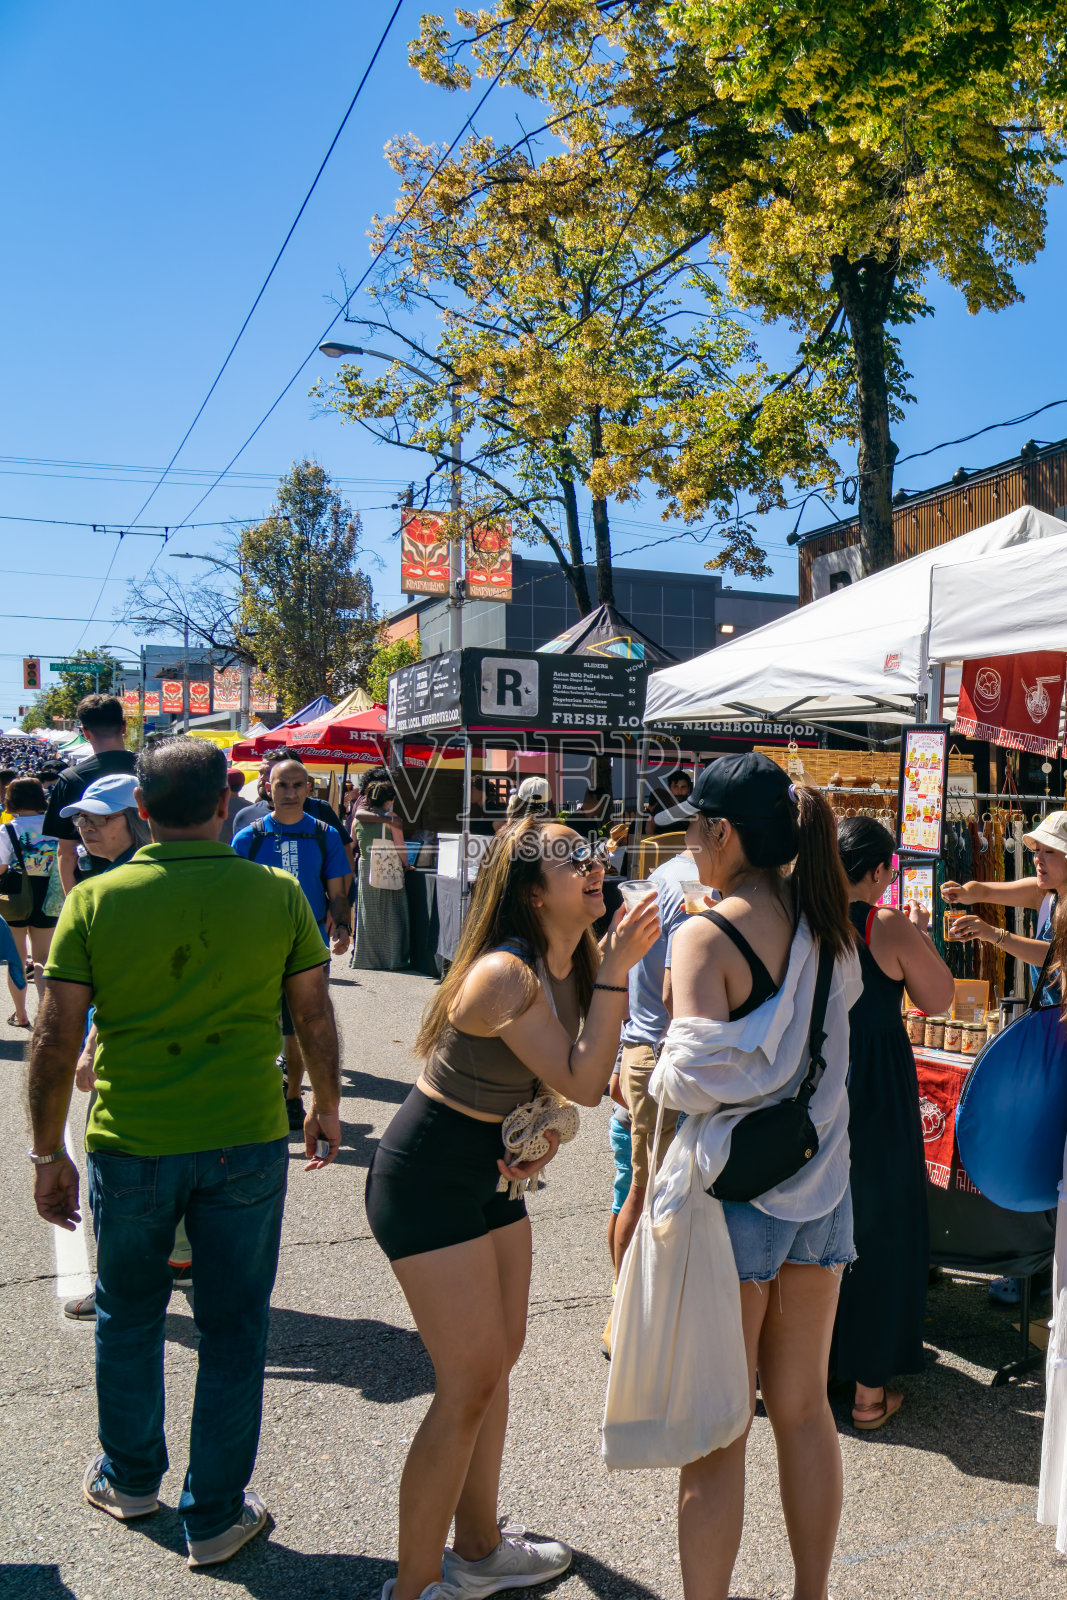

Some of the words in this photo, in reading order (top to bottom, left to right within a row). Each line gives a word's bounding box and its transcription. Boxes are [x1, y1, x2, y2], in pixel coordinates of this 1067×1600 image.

[625, 659, 648, 673] WOW!
[497, 668, 522, 706] R
[551, 712, 612, 726] FRESH.
[305, 746, 330, 756] Built
[331, 750, 359, 759] Craft
[359, 753, 382, 762] Beer
